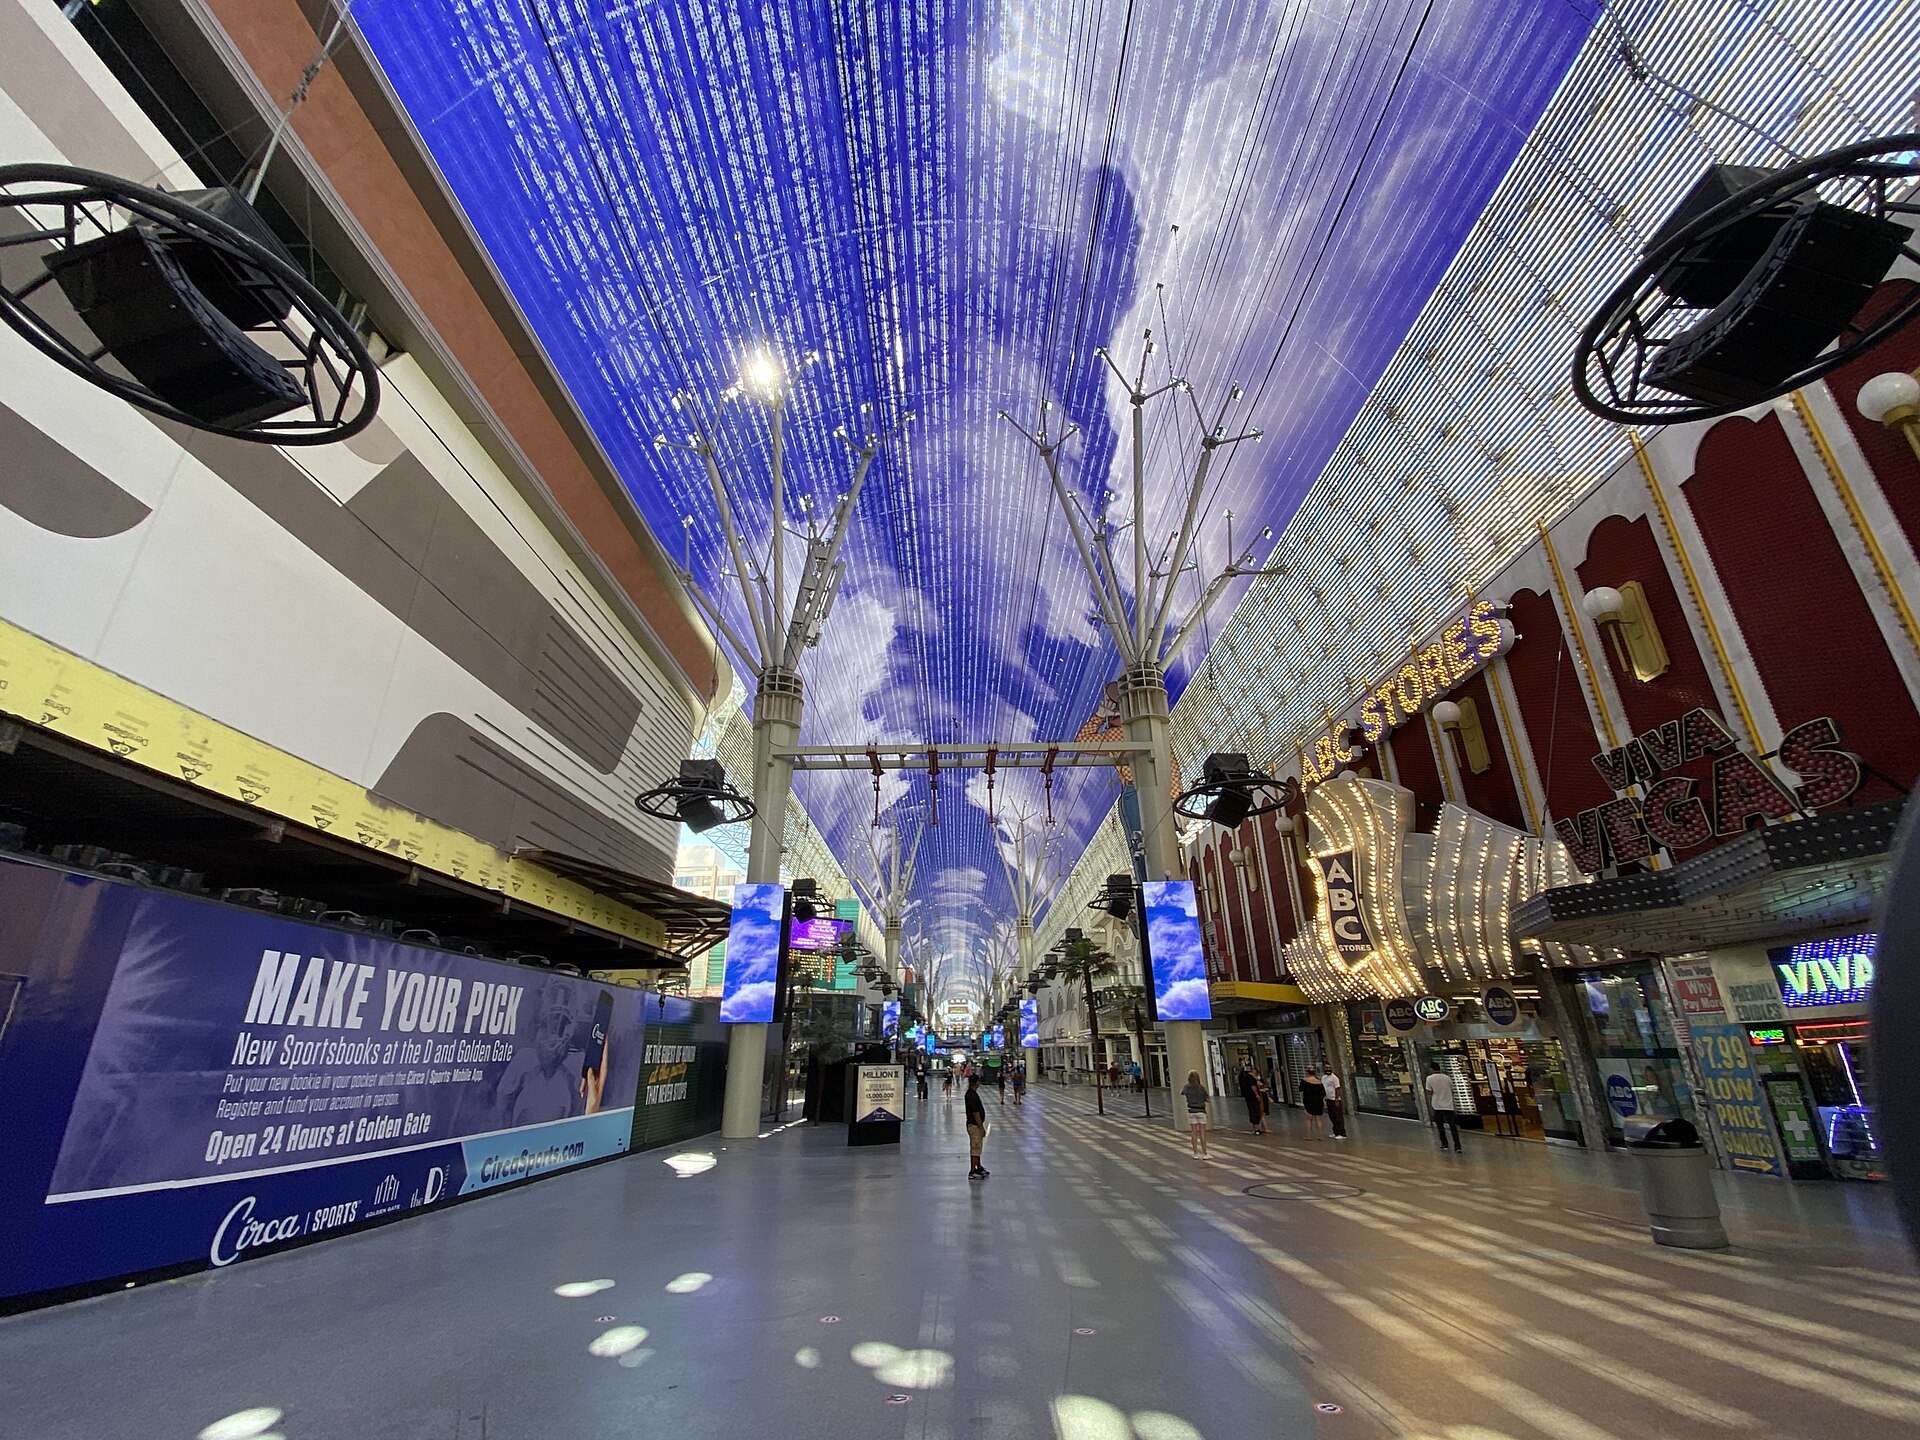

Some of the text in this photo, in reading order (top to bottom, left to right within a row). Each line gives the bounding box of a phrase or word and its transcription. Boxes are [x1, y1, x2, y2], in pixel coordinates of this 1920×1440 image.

[1301, 600, 1503, 793] ABC STORES
[1591, 707, 1738, 791] VIVA
[1553, 716, 1862, 876] VEGAS
[1326, 858, 1362, 941] ABC
[1339, 944, 1373, 952] STORES
[244, 950, 524, 1036] MAKE YOUR PICK
[1685, 980, 1713, 996] Why
[1389, 1007, 1414, 1018] ABC
[1420, 999, 1444, 1013] ABC
[1488, 997, 1513, 1008] ABC
[1682, 998, 1700, 1011] Pay
[1754, 1029, 1785, 1038] CIGARS
[231, 1032, 513, 1070] New Sportsbooks at the D and Golden Gate
[1694, 1036, 1749, 1069] $7.99
[223, 1074, 243, 1093] Put
[244, 1077, 268, 1095] your
[268, 1077, 290, 1092] new
[290, 1073, 321, 1091] bookie
[321, 1073, 331, 1090] in
[331, 1074, 350, 1091] your
[350, 1072, 378, 1090] pocket
[378, 1071, 395, 1087] with
[395, 1071, 406, 1086] the
[406, 1070, 425, 1085] Circa
[452, 1068, 472, 1082] Mobile
[862, 1071, 894, 1079] MILLION
[1609, 1085, 1632, 1098] ABC
[1707, 1078, 1754, 1101] LOW
[216, 1099, 263, 1120] Register
[264, 1097, 285, 1116] and
[285, 1096, 309, 1114] fund
[309, 1097, 330, 1114] your
[329, 1094, 364, 1111] account
[363, 1094, 372, 1108] in
[1715, 1104, 1767, 1129] PRICE
[204, 1112, 432, 1165] Open 24 Hours at Golden Gate
[480, 1139, 584, 1184] CircaSports.com
[410, 1188, 424, 1208] the
[423, 1166, 444, 1205] D
[365, 1203, 401, 1218] GOLDEN GATE
[210, 1196, 302, 1268] Circa
